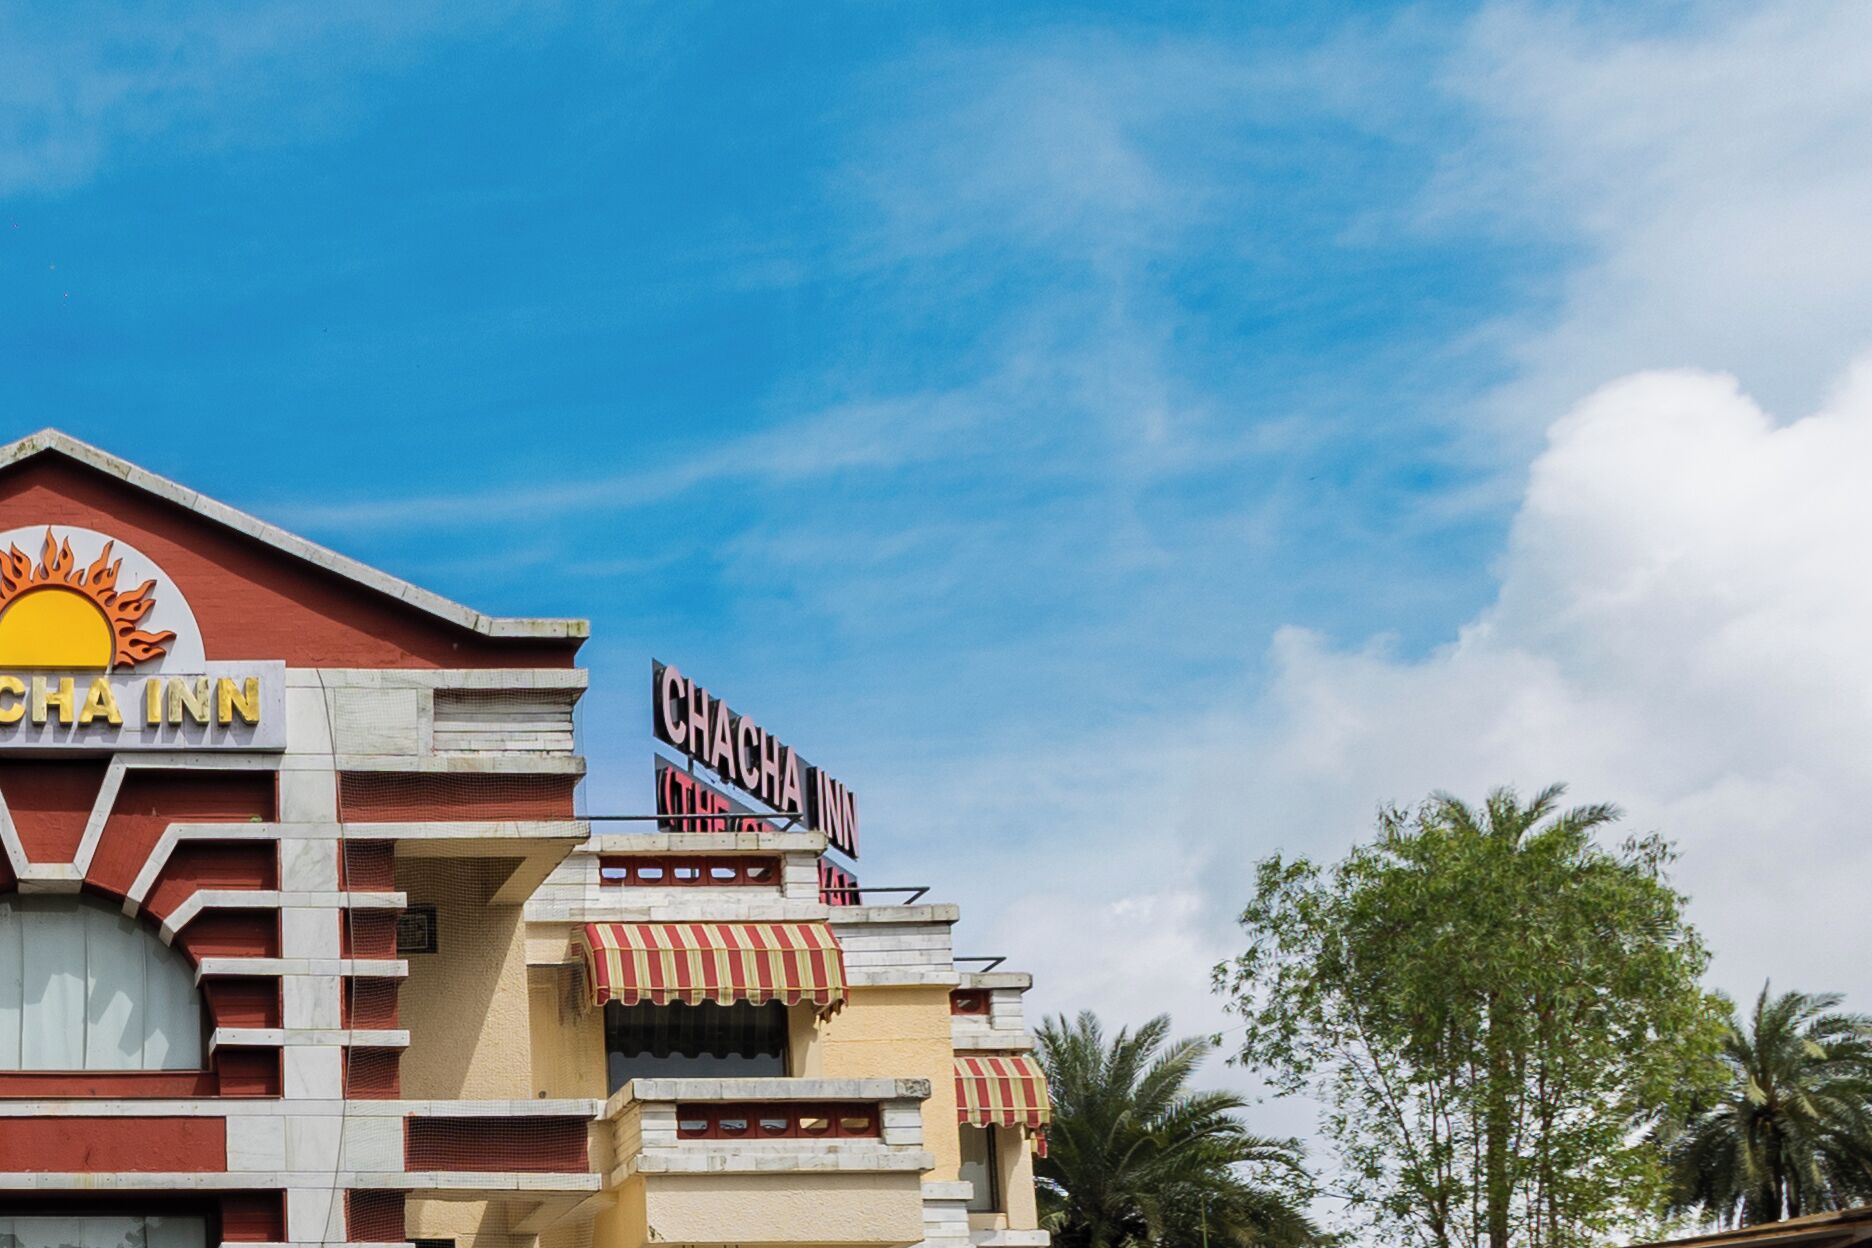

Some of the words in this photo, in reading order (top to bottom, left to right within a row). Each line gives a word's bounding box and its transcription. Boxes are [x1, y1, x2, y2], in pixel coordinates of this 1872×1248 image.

[146, 676, 260, 726] INN
[662, 664, 803, 820] CHACHA
[816, 766, 859, 859] INN
